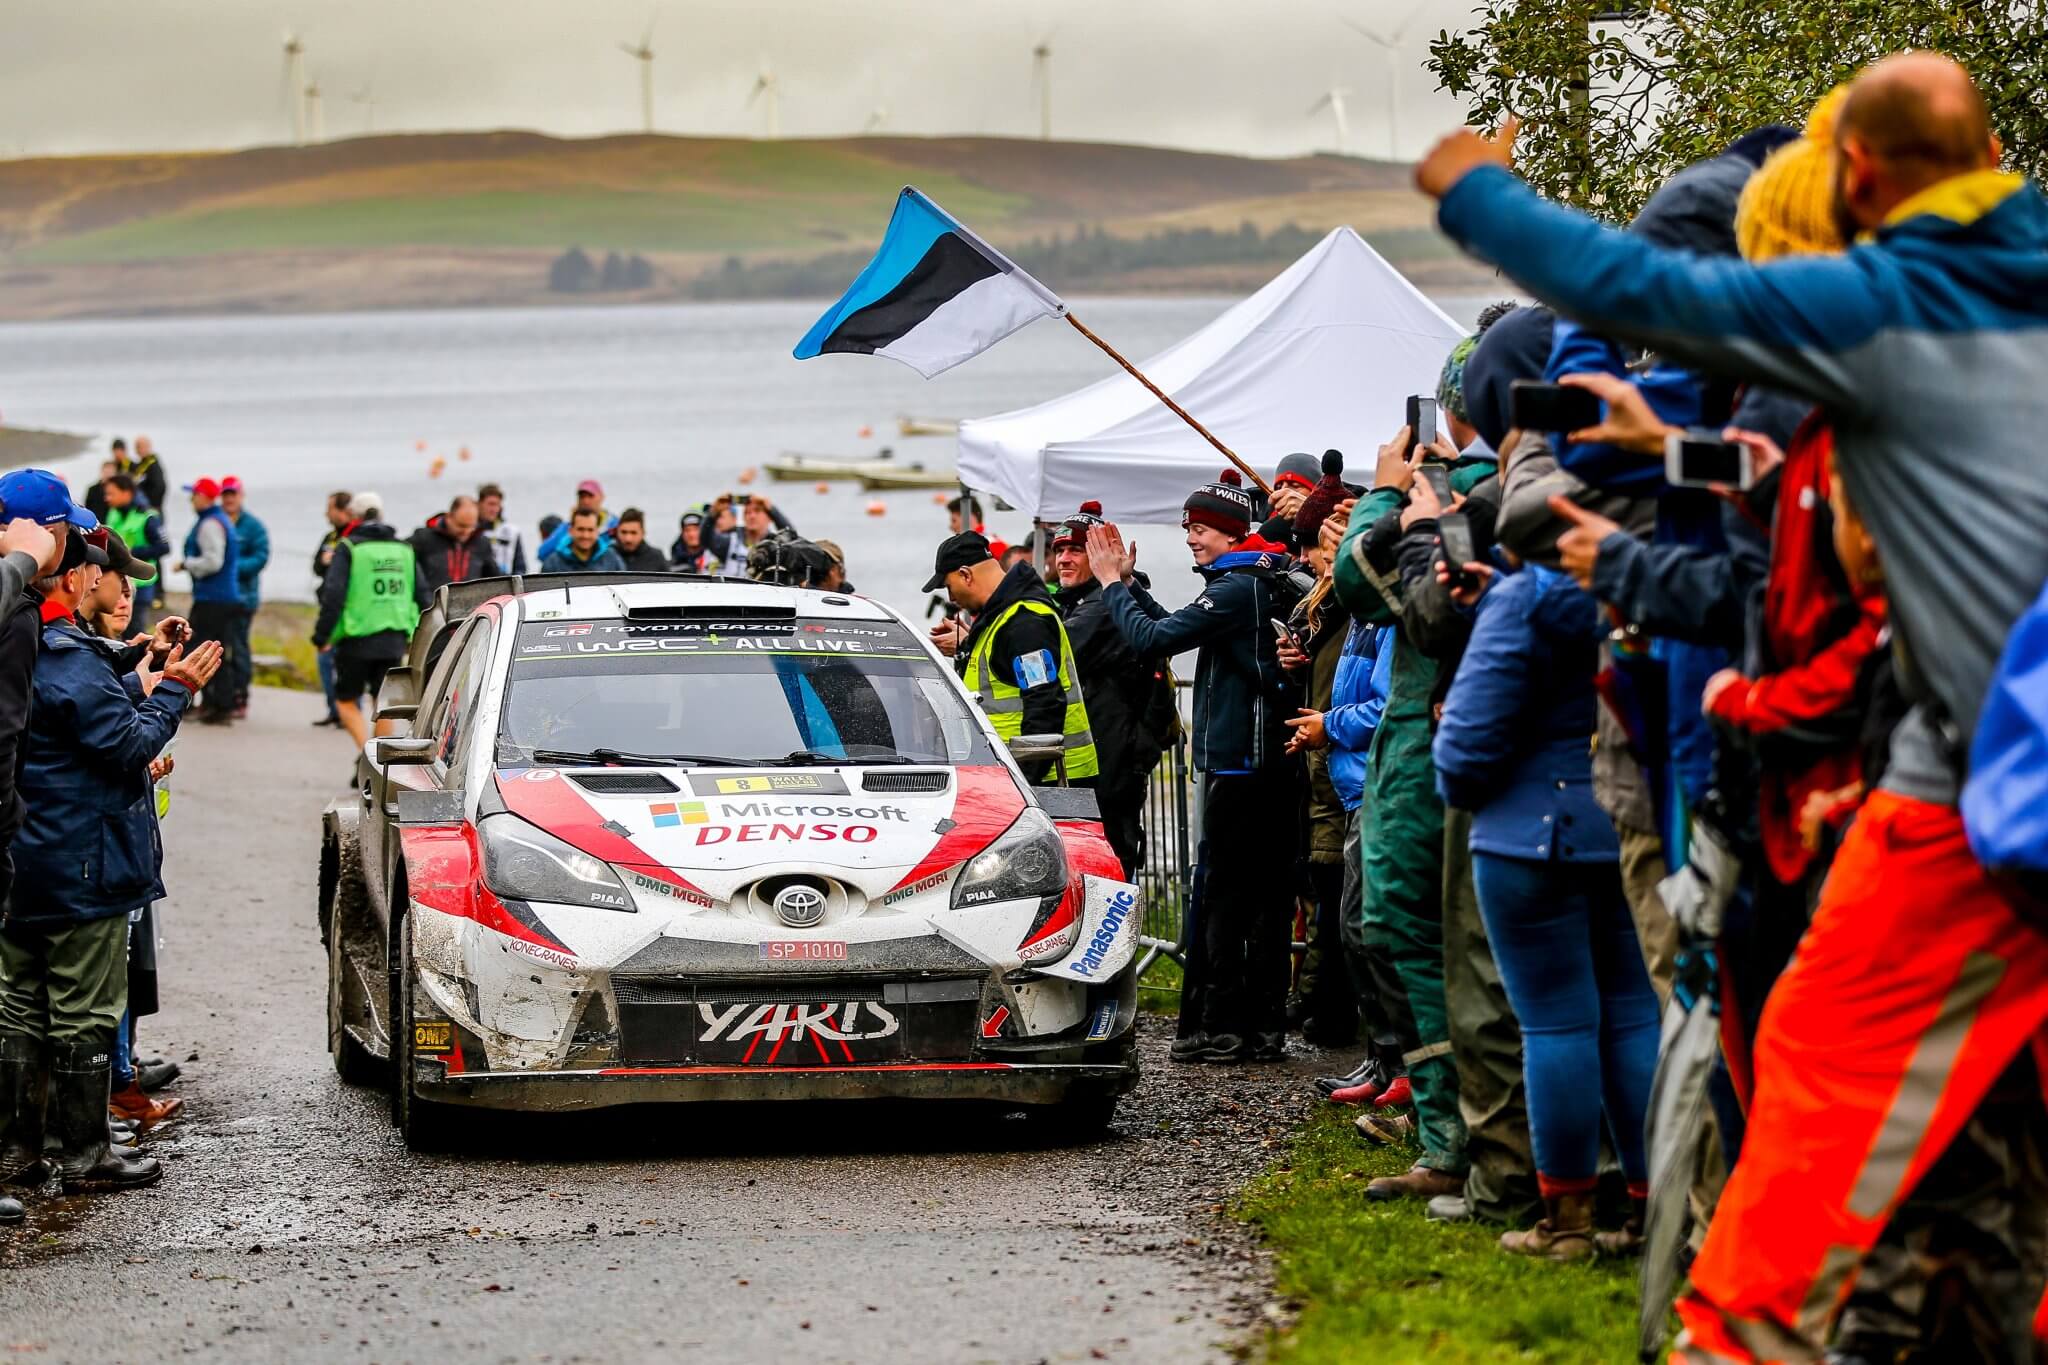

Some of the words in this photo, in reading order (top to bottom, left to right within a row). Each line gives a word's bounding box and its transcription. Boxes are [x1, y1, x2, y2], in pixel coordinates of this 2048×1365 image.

[1216, 488, 1249, 507] WALES
[600, 624, 702, 633] TOYOTA
[708, 623, 799, 631] GAZOO
[802, 624, 888, 637] Racing
[735, 638, 791, 650] ALL
[798, 638, 865, 652] LIVE
[736, 779, 751, 790] 8
[720, 803, 910, 822] Microsoft
[695, 824, 878, 846] DENSO
[634, 875, 671, 895] DMG
[672, 887, 714, 909] MORI
[883, 886, 914, 906] DMG
[915, 871, 949, 893] MORI
[965, 889, 997, 902] PIAA
[590, 892, 625, 905] PIAA
[1069, 890, 1135, 977] Panasonic
[509, 940, 578, 971] KONECRANES
[771, 943, 796, 958] SP
[802, 943, 843, 958] 1010
[1017, 933, 1069, 962] KONECRANES
[698, 1001, 900, 1042] YARIS
[415, 1027, 450, 1045] OMP
[92, 1053, 108, 1063] site
